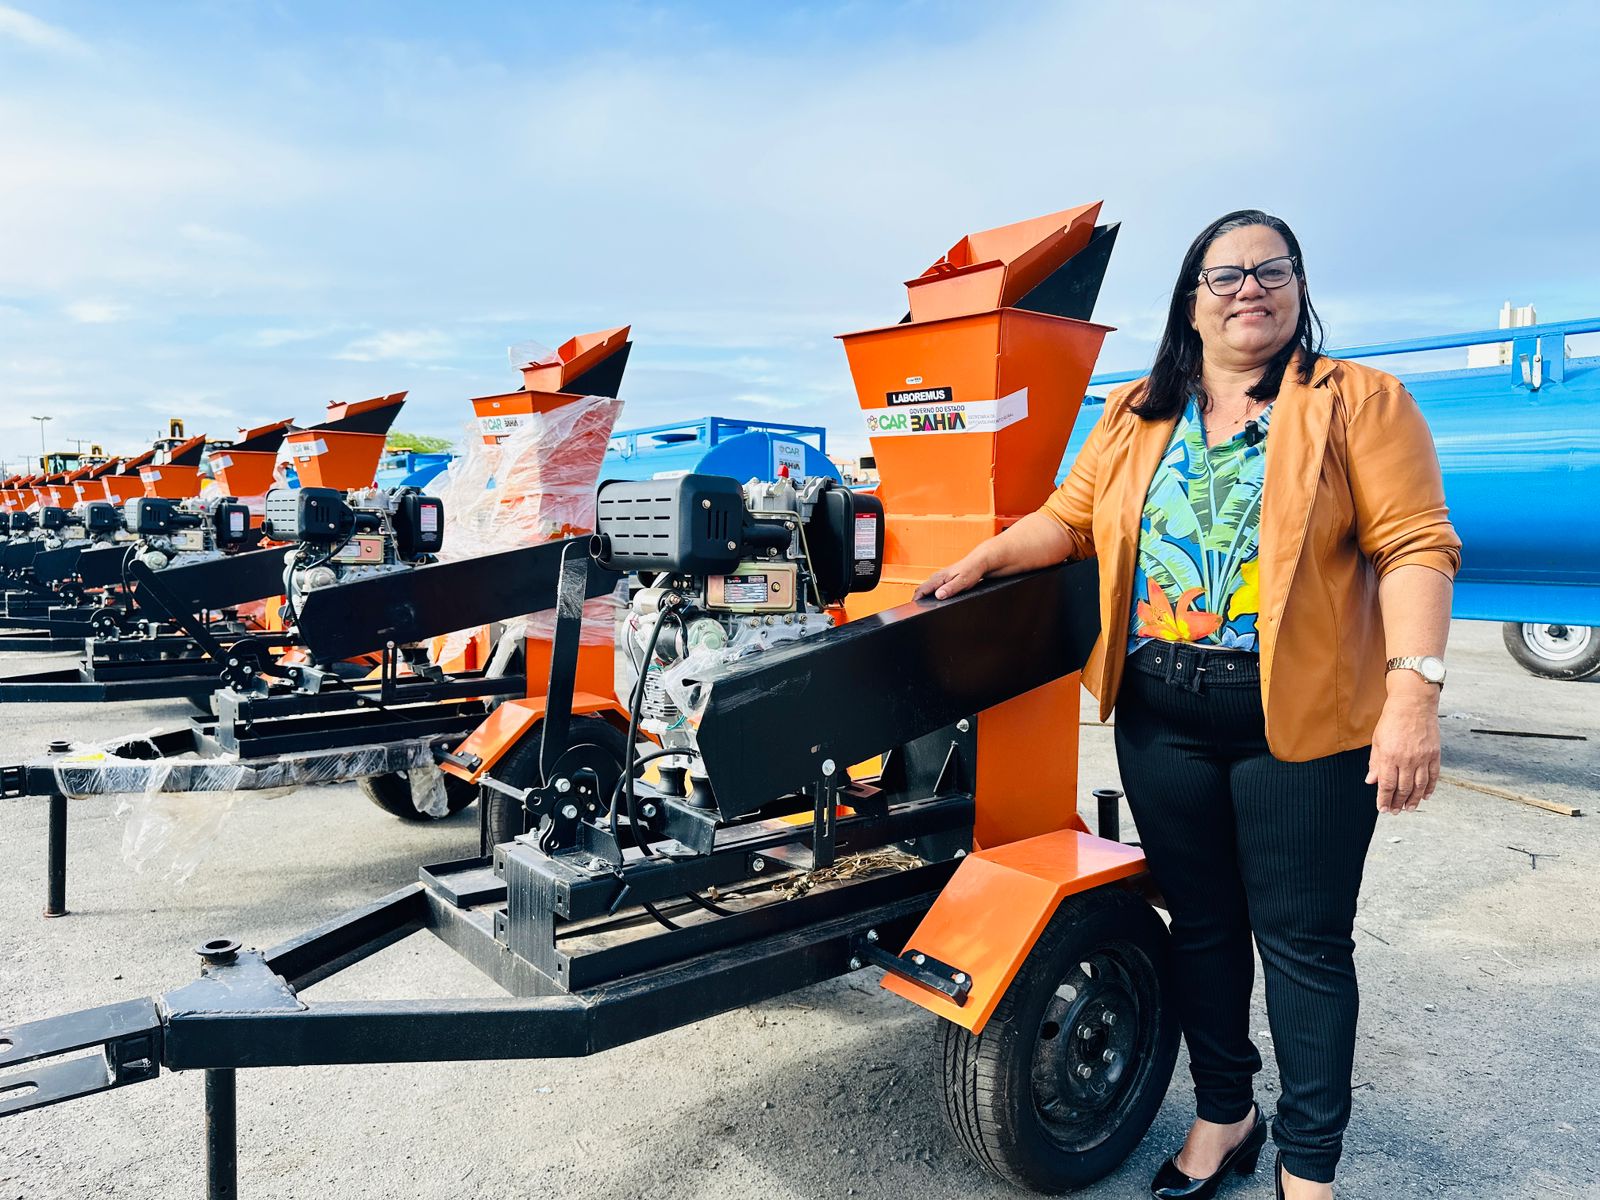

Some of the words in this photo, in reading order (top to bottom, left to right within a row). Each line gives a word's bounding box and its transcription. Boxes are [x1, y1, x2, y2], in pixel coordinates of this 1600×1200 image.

[892, 390, 945, 404] LABOREMUS
[909, 407, 935, 415] GOVERNO
[488, 418, 503, 430] CAR
[879, 414, 907, 430] CAR
[910, 412, 966, 432] BAHIA
[785, 446, 800, 455] CAR
